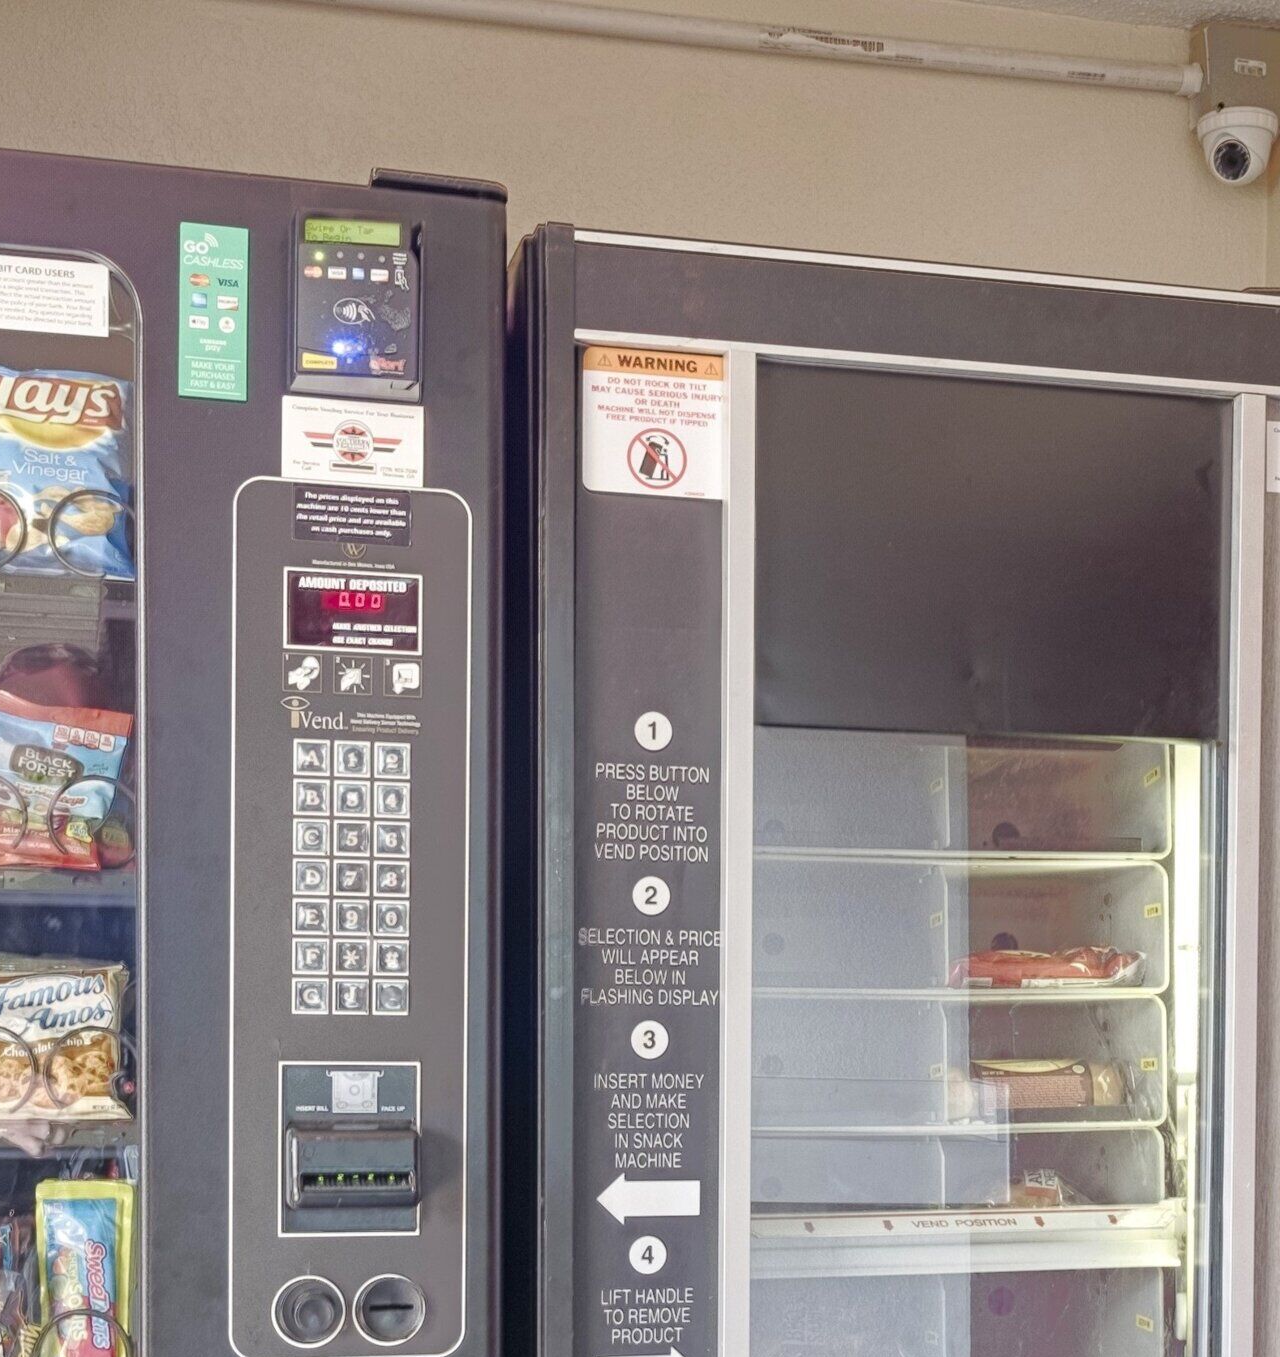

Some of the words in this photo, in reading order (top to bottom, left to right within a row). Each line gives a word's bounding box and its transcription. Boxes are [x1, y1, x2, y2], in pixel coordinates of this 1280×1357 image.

[183, 240, 209, 254] GO
[183, 255, 244, 271] CASHLESS
[15, 265, 42, 276] CARD
[45, 268, 76, 279] USERS
[216, 278, 239, 288] VISA
[191, 360, 212, 370] MAKE
[214, 362, 235, 372] YOUR
[617, 354, 698, 373] WARNING
[191, 370, 236, 381] PURCHASES
[607, 376, 620, 385] DO
[623, 377, 642, 386] NOT
[645, 379, 670, 388] ROCK
[673, 380, 685, 389] OR
[689, 382, 707, 391] TILT
[190, 379, 208, 389] FAST
[216, 382, 236, 390] EASY
[591, 384, 611, 393] MAY
[615, 387, 645, 396] CAUSE
[648, 389, 688, 399] SERIOUS
[691, 391, 723, 402] INJURY
[634, 397, 648, 406] OR
[650, 399, 680, 409] DEATH
[597, 404, 635, 414] MACHINE
[637, 407, 656, 416] WILL
[659, 408, 675, 417] NOT
[677, 410, 717, 420] DISPENSE
[606, 413, 627, 422] FREE
[629, 415, 666, 425] PRODUCT
[680, 419, 708, 428] TIPPED
[23, 448, 61, 466] Salt
[65, 455, 77, 466] &
[12, 460, 89, 482] Vinegar
[305, 491, 317, 499] The
[318, 492, 339, 502] prices
[340, 494, 375, 505] displayed
[385, 498, 399, 506] this
[296, 503, 326, 511] machine
[350, 506, 369, 514] cents
[370, 507, 389, 515] lower
[390, 508, 406, 517] than
[296, 513, 307, 521] the
[309, 514, 327, 522] retail
[329, 516, 347, 525] price
[375, 518, 406, 528] available
[321, 525, 337, 533] cash
[338, 527, 374, 537] purchases
[375, 529, 393, 538] only.
[298, 576, 347, 590] AMOUNT
[349, 578, 407, 593] DEPOSITED
[332, 622, 351, 631] MAKE
[353, 623, 382, 632] ANOTHER
[383, 624, 417, 633] SELECTION
[648, 721, 656, 740] 1
[25, 748, 72, 769] BLACK
[18, 759, 76, 778] FOREST
[595, 762, 645, 781] PRESS
[649, 765, 710, 783] BUTTON
[626, 784, 679, 802] BELOW
[610, 803, 631, 820] TO
[635, 804, 694, 822] ROTATE
[596, 822, 669, 841] PRODUCT
[673, 826, 708, 843] INTO
[594, 843, 635, 860] VEND
[639, 845, 709, 863] POSITION
[644, 885, 658, 905] 2
[578, 927, 661, 946] SELECTION
[665, 930, 674, 946] &
[679, 930, 721, 947] PRICE
[601, 949, 636, 965] WILL
[640, 949, 699, 966] APPEAR
[615, 968, 668, 985] BELOW
[672, 970, 686, 985] IN
[580, 988, 654, 1006] FLASHING
[658, 989, 719, 1006] DISPLAY
[25, 1002, 111, 1030] Amos
[643, 1029, 656, 1049] 3
[593, 1073, 647, 1091] INSERT
[651, 1073, 705, 1090] MONEY
[611, 1093, 642, 1109] AND
[646, 1093, 687, 1109] MAKE
[607, 1113, 690, 1129] SELECTION
[614, 1132, 629, 1148] IN
[633, 1132, 683, 1149] SNACK
[614, 1152, 682, 1169] MACHINE
[911, 1220, 949, 1228] VEND
[955, 1218, 1018, 1228] POSITION
[641, 1245, 655, 1265] 4
[601, 1288, 631, 1305] LIFT
[635, 1287, 694, 1304] HANDLE
[603, 1309, 624, 1325] TO
[628, 1306, 691, 1324] REMOVE
[611, 1327, 684, 1344] PRODUCT
